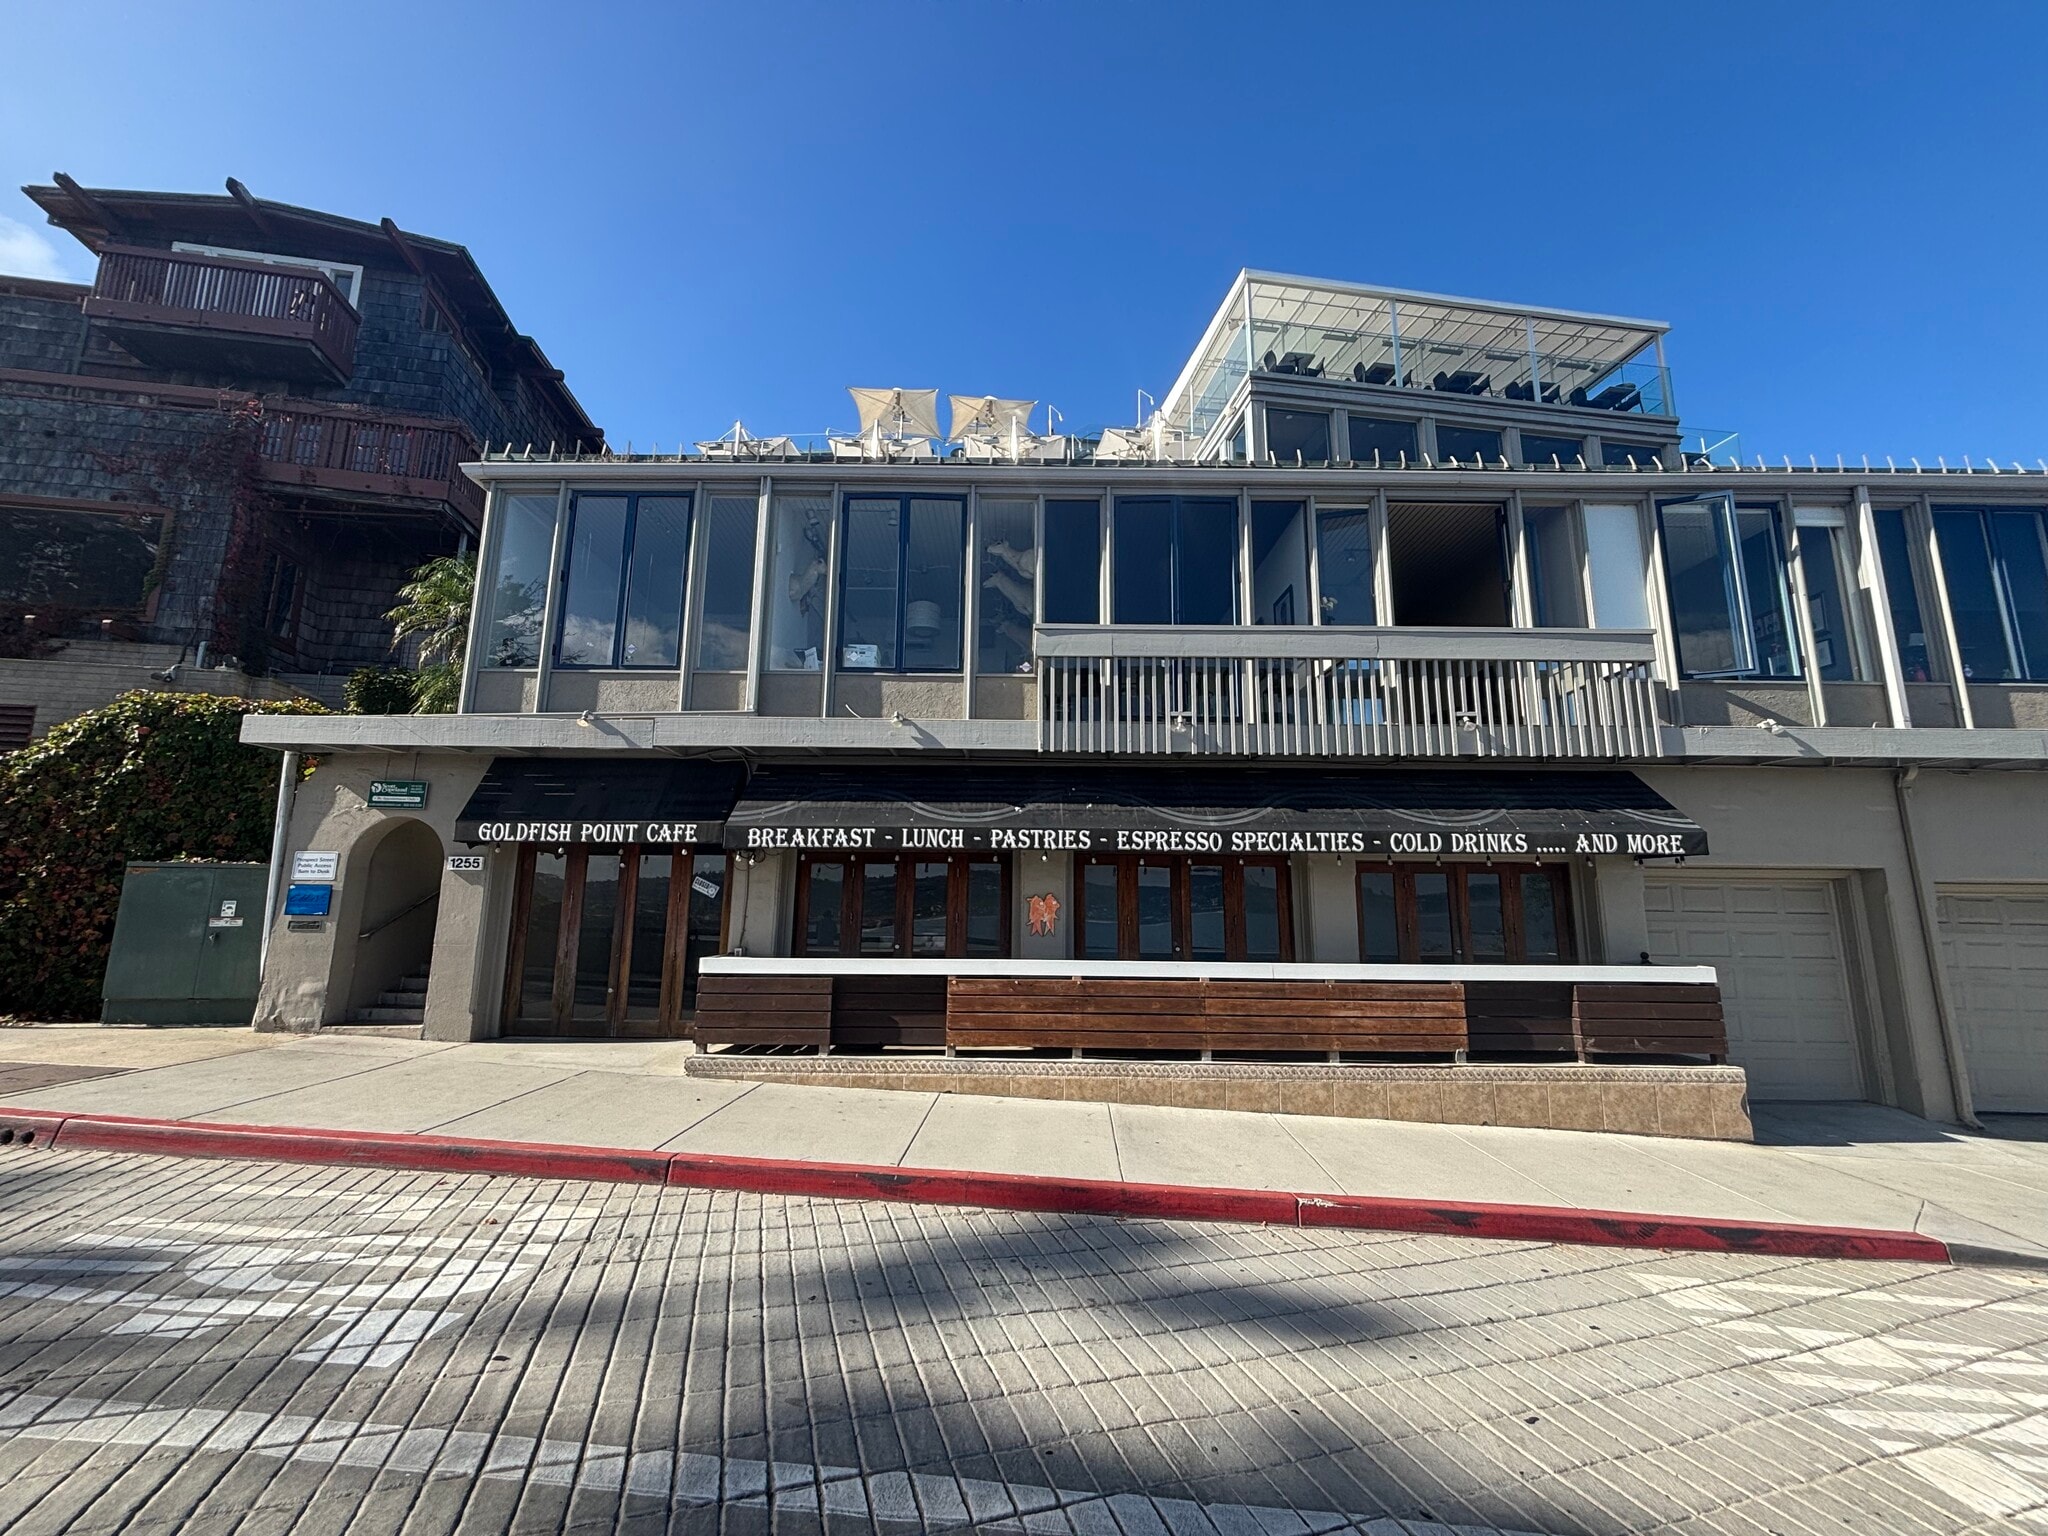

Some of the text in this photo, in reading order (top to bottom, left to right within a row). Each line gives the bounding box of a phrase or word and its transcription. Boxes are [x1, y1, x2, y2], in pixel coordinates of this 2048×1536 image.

[478, 823, 698, 842] GOLDFISH POINT CAFE
[747, 828, 876, 848] BREAKFAST
[901, 828, 965, 848] LUNCH
[990, 829, 1092, 850] PASTRIES
[1116, 830, 1223, 852] ESPRESSO
[1231, 832, 1365, 852] SPECIALTIES
[1390, 832, 1443, 853] COLD
[1451, 833, 1528, 854] DRINKS
[1575, 833, 1618, 854] AND
[1627, 834, 1686, 854] MORE
[450, 858, 480, 868] 1255
